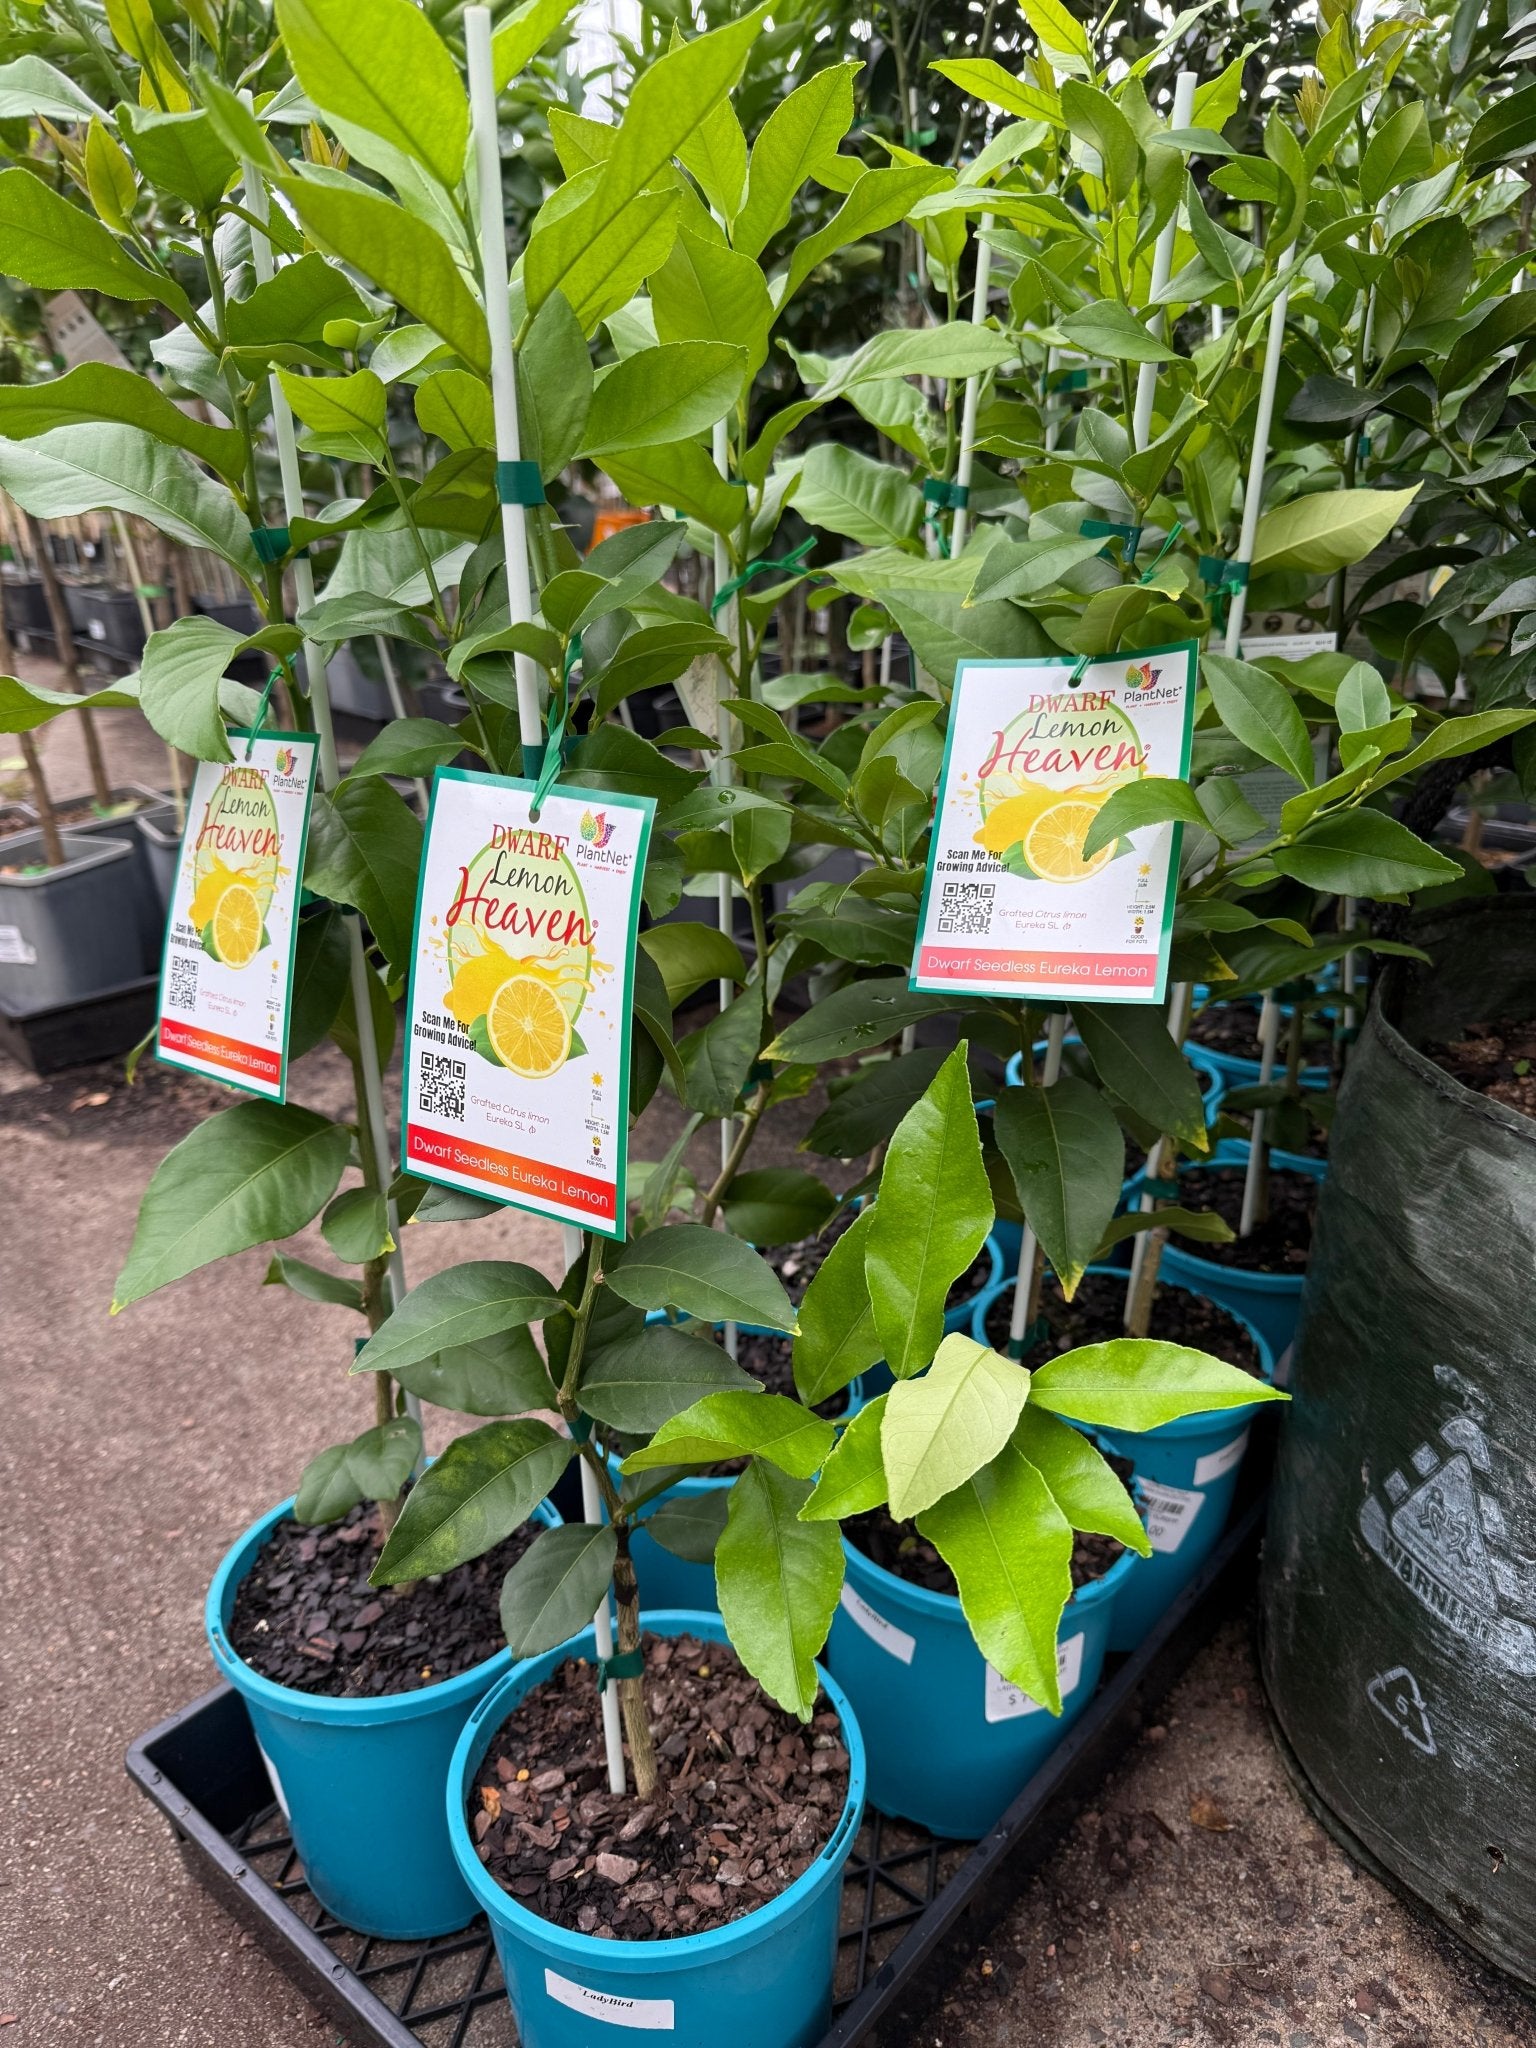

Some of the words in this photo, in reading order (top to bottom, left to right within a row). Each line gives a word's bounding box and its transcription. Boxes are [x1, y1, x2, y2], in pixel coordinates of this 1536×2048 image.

[1027, 690, 1116, 714] DWARF
[1028, 712, 1122, 740] Lemon
[221, 765, 270, 790] DWARF
[220, 785, 271, 818] Lemon
[489, 823, 570, 861] DWARF
[947, 849, 969, 860] Scan
[971, 850, 985, 860] Me
[988, 850, 1003, 860] For
[489, 850, 574, 896] Lemon
[936, 861, 973, 873] Growing
[976, 861, 1010, 873] Advice!
[998, 909, 1034, 919] Grafted
[1035, 910, 1061, 919] Citrus
[1062, 910, 1088, 919] limon
[1015, 920, 1045, 929] Eureka
[1047, 921, 1059, 930] SL
[927, 956, 972, 971] Dwarf
[974, 958, 1036, 974] Seedless
[1039, 962, 1091, 976] Eureka
[1094, 963, 1149, 978] Lemon
[422, 1010, 441, 1027] Scan
[443, 1016, 456, 1030] Me
[457, 1020, 470, 1035] For
[414, 1023, 446, 1045] Growing
[447, 1033, 477, 1052] Advice!
[164, 1027, 188, 1044] Dwarf
[187, 1034, 220, 1056] Seedless
[220, 1045, 248, 1065] Eureka
[249, 1054, 277, 1075] Lemon
[470, 1095, 501, 1112] Grafted
[502, 1104, 527, 1120] Citrus
[527, 1110, 550, 1125] limon
[486, 1112, 513, 1128] Eureka
[514, 1120, 525, 1132] SL
[413, 1135, 453, 1160] Dwarf
[454, 1149, 510, 1178] Seedless
[512, 1165, 558, 1192] Eureka
[561, 1179, 609, 1208] Lemon
[582, 1990, 634, 2007] LadyBird
